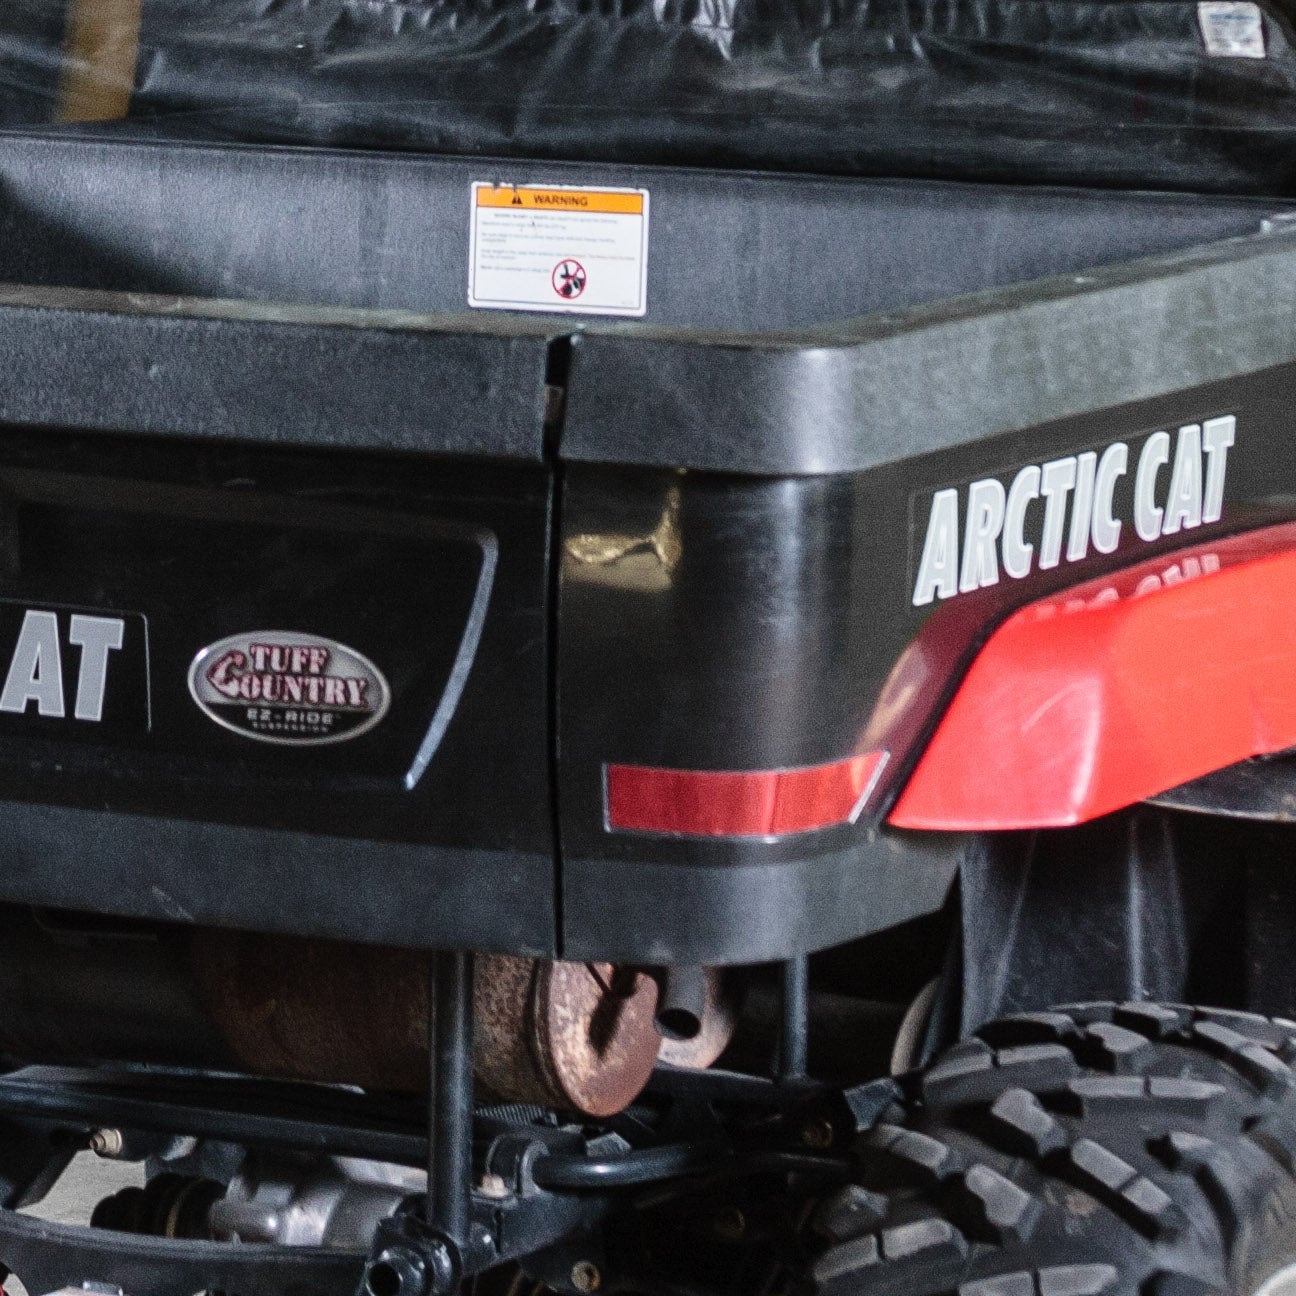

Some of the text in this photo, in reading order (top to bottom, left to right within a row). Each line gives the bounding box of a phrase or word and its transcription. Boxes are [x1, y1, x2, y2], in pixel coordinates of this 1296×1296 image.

[533, 194, 589, 206] WARNING
[912, 414, 1236, 606] ARCTIC CAT
[207, 650, 369, 708] COUNTRY
[250, 643, 330, 675] TUFF
